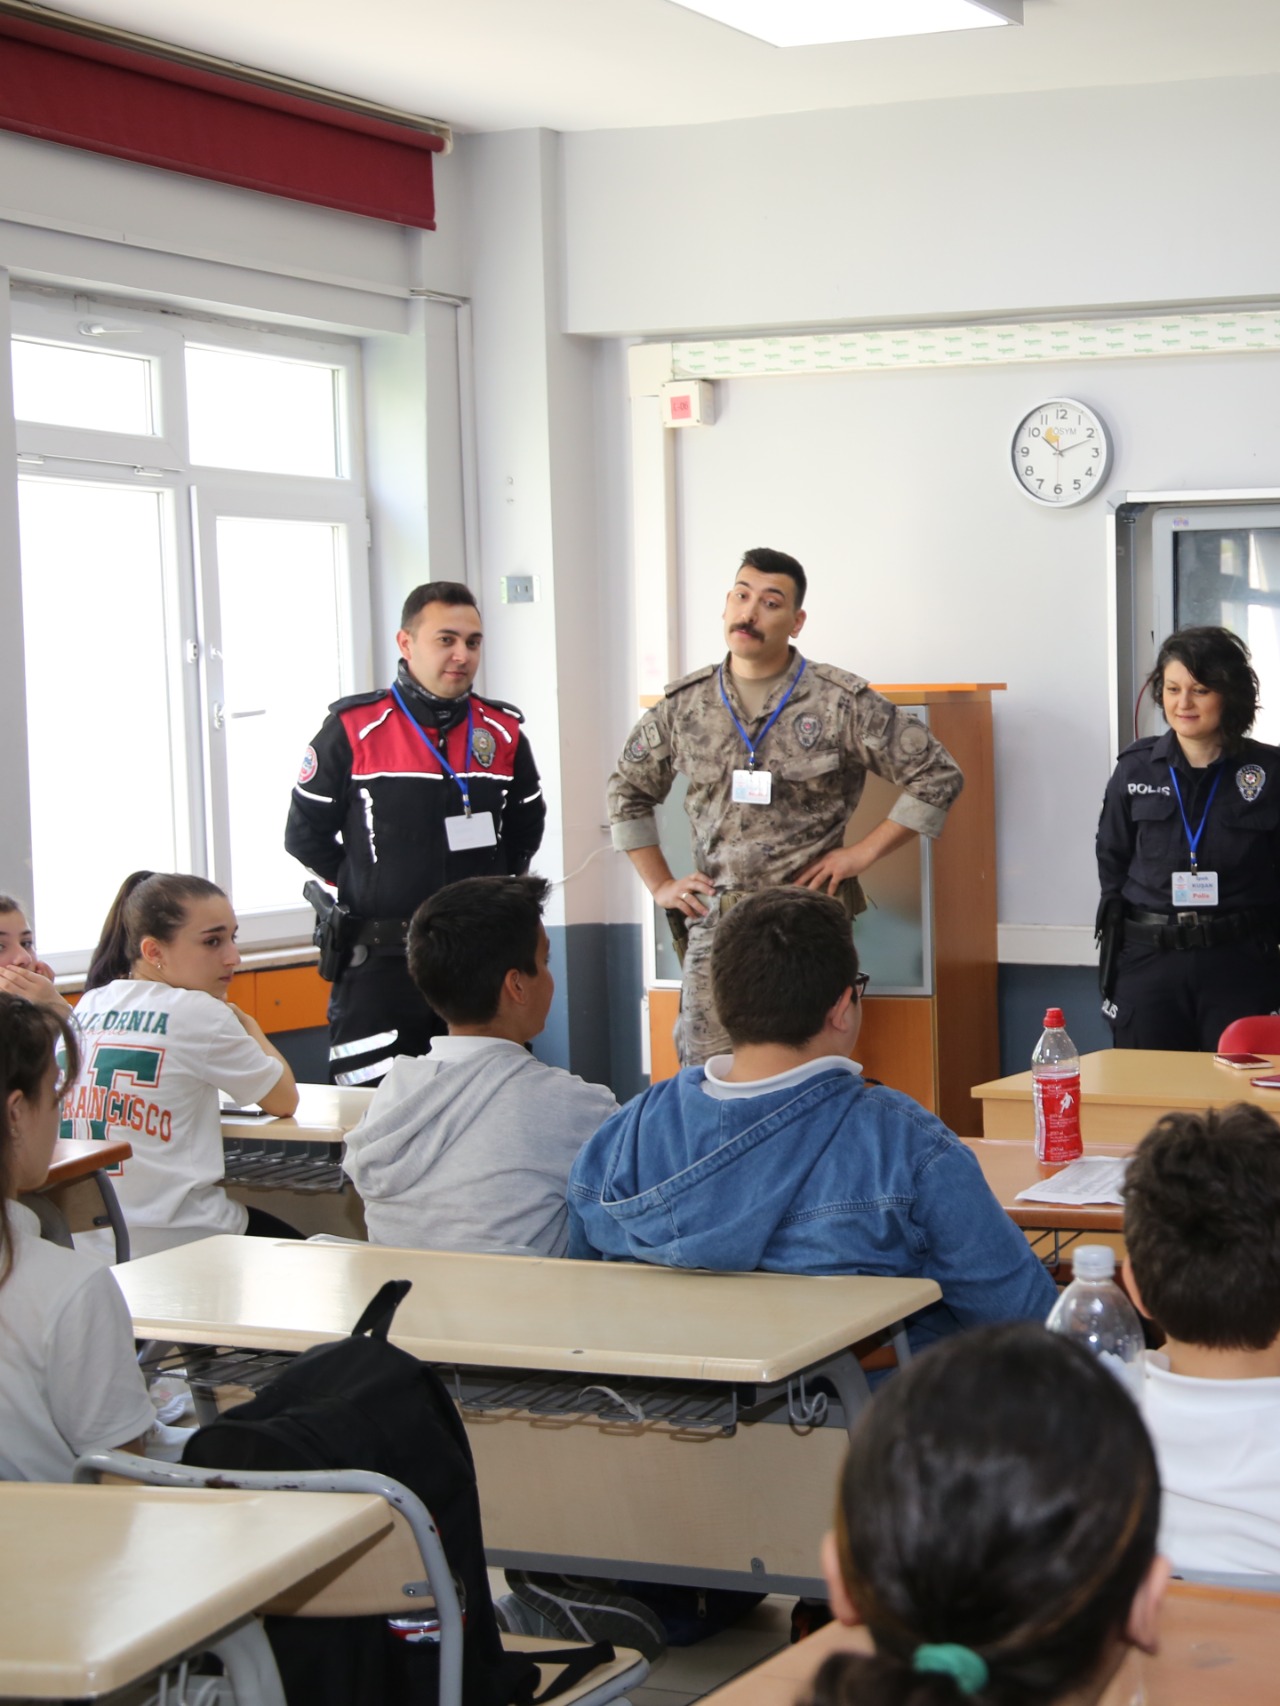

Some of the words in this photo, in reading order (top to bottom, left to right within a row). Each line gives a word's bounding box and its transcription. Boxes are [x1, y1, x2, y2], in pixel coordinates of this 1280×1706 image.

[1040, 414, 1048, 425] 11
[1056, 409, 1068, 420] 12
[1028, 427, 1041, 438] 10
[1086, 428, 1095, 439] 2
[1020, 446, 1030, 457] 9
[1091, 447, 1100, 458] 3
[1024, 465, 1034, 477] 8
[1084, 467, 1093, 477] 4
[1036, 479, 1044, 489] 7
[1053, 484, 1063, 495] 6
[1073, 479, 1081, 490] 5
